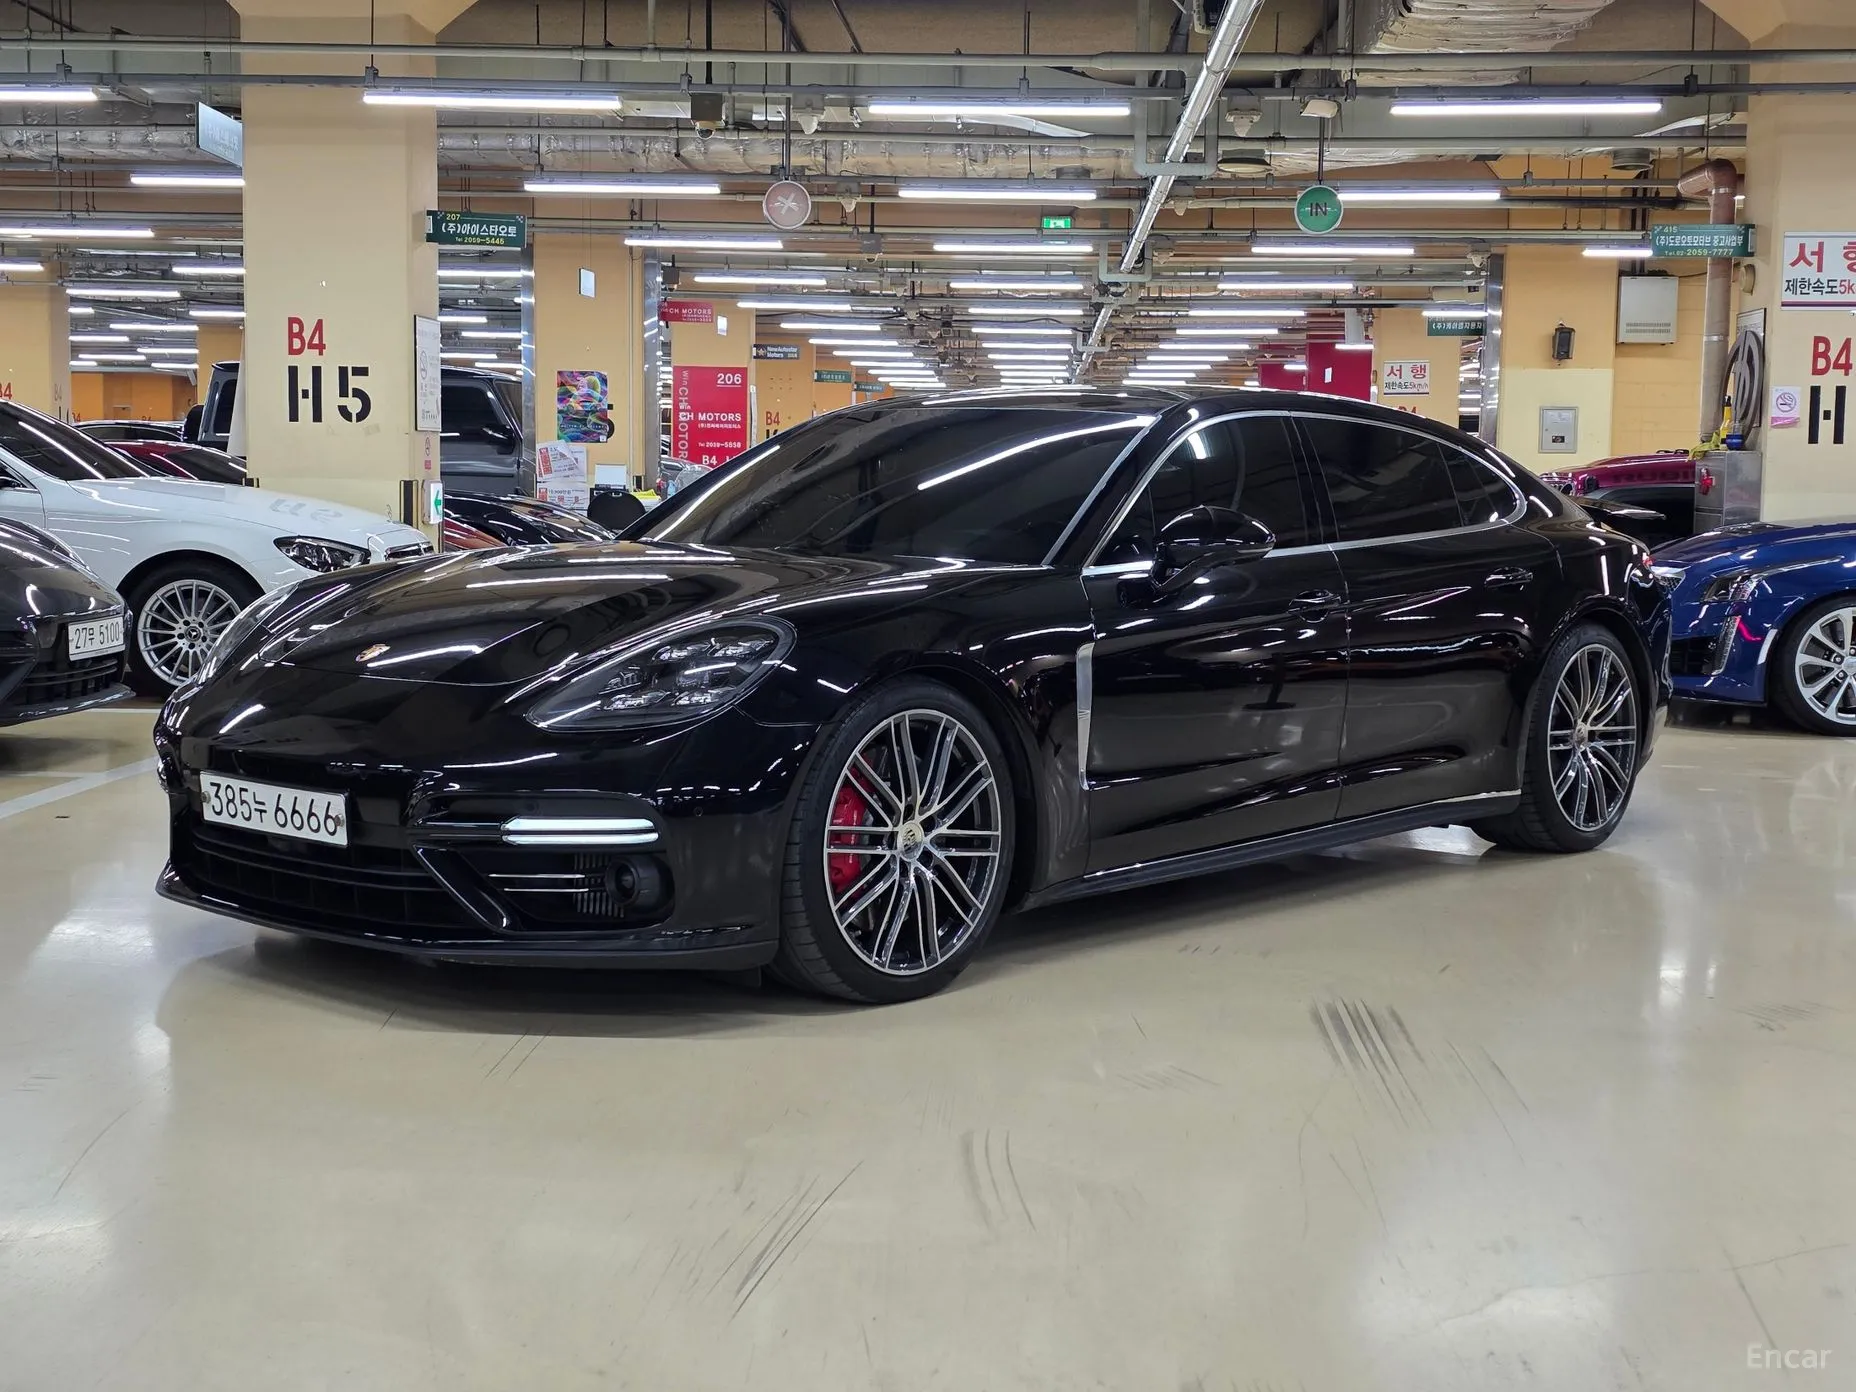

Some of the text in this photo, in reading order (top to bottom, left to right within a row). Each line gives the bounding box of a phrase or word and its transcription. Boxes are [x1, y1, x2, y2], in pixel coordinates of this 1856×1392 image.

[1310, 202, 1327, 216] IN
[441, 223, 517, 237] (주)아이스타오토
[1788, 241, 1825, 273] 서
[287, 316, 326, 356] B4
[1811, 335, 1853, 376] B4
[716, 373, 742, 385] 206
[1387, 364, 1427, 380] 서 행
[0, 382, 13, 400] 4
[698, 412, 742, 422] MOTORS
[765, 411, 780, 426] B4
[702, 454, 718, 466] B4
[99, 621, 120, 645] 5100
[209, 781, 338, 837] 385누 6666
